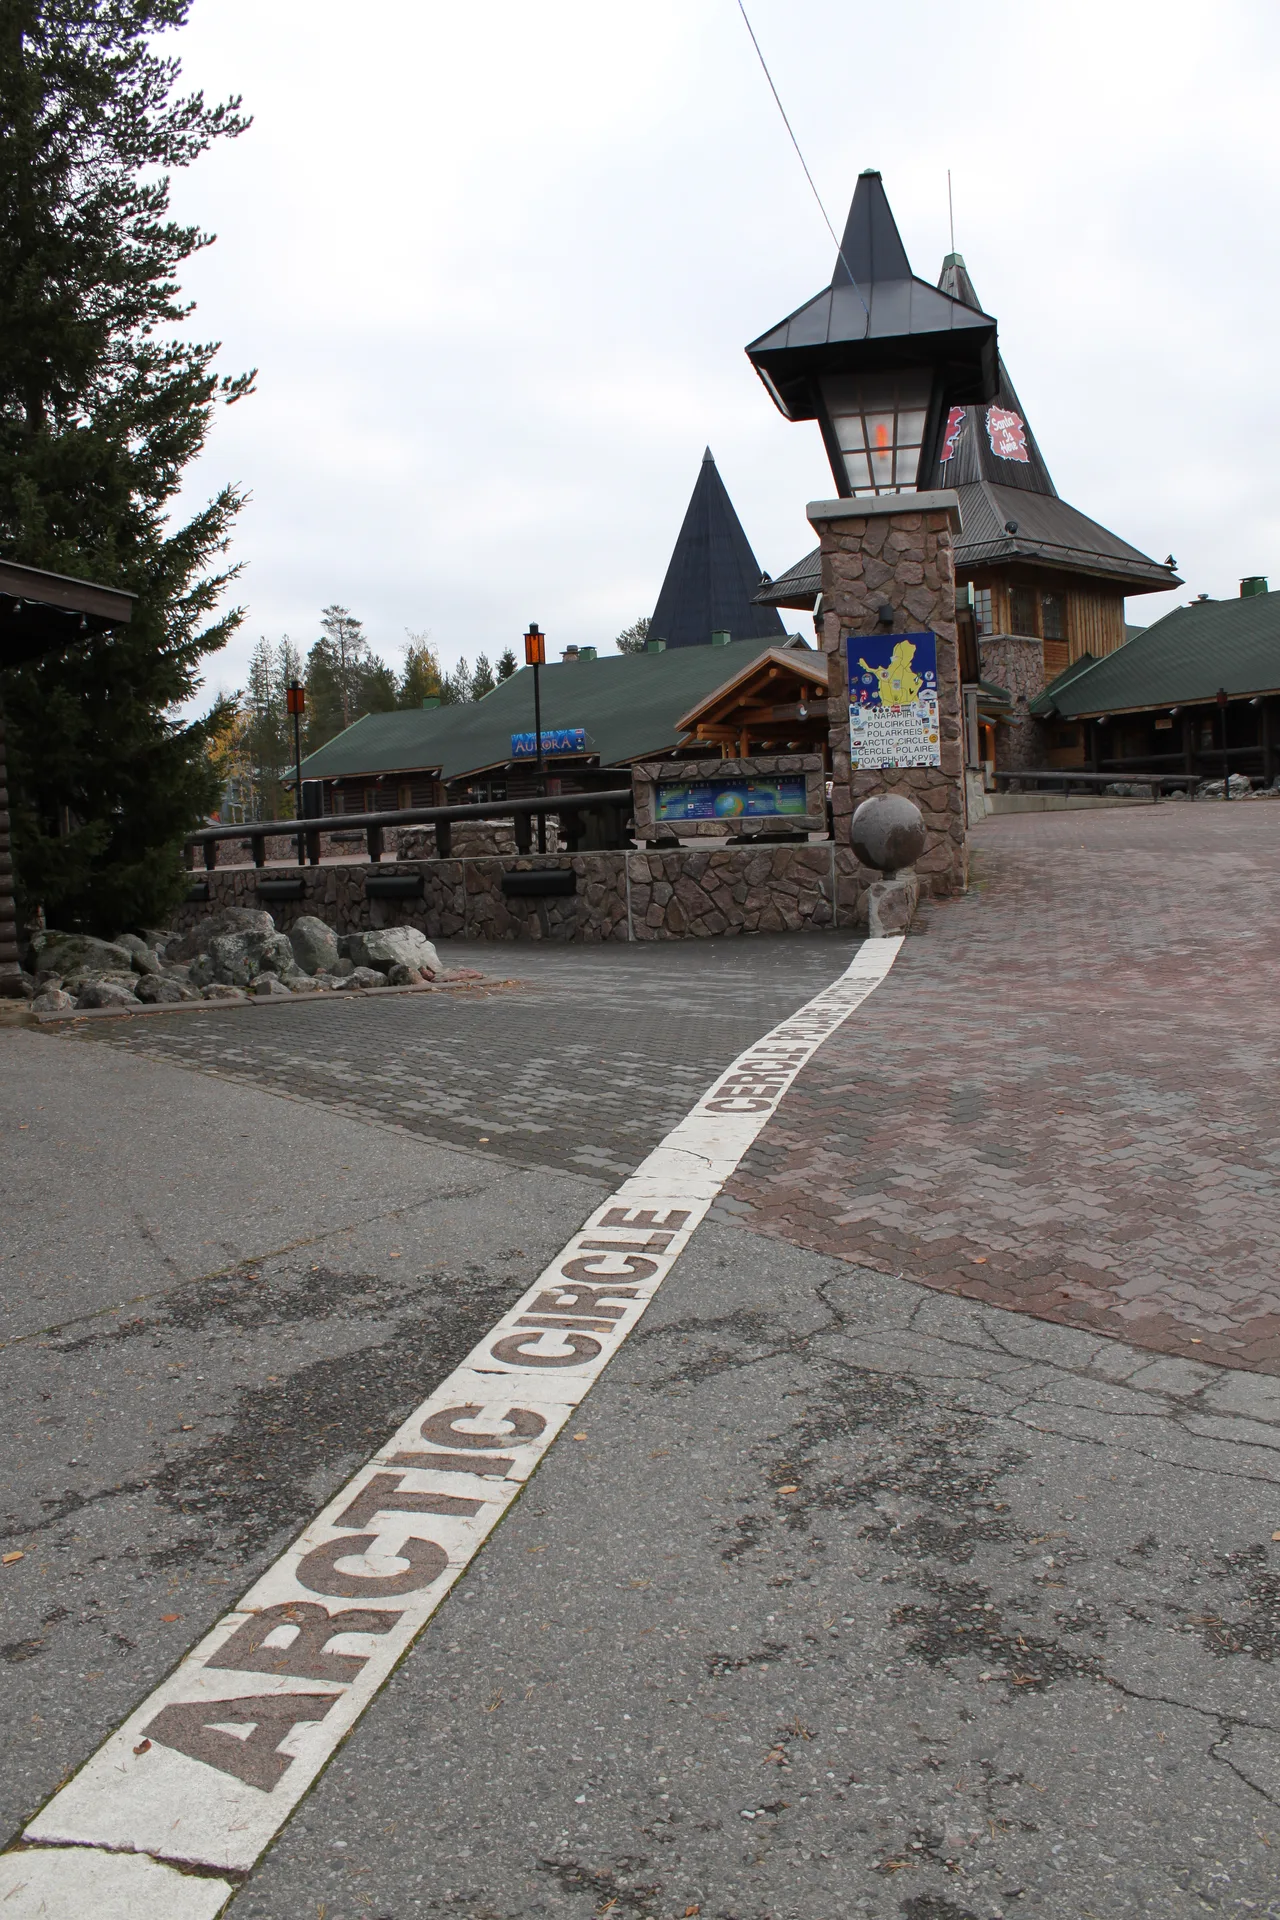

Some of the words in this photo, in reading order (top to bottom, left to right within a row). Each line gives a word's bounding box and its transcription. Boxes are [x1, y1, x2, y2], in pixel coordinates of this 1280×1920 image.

[991, 415, 1015, 432] Santa
[873, 711, 915, 719] NAPAPIIRI
[867, 720, 922, 729] POLCIRKELN
[867, 728, 923, 738] POLARKREIS
[862, 738, 894, 747] ARCTIC
[897, 736, 929, 746] CIRCLE
[857, 747, 892, 756] CERCLE
[895, 745, 934, 754] POLAIRE
[704, 1047, 811, 1113] CERCLE
[766, 1007, 850, 1042] POLAIRE
[139, 1404, 547, 1794] ARCTIC
[490, 1207, 692, 1368] CIRCLE
